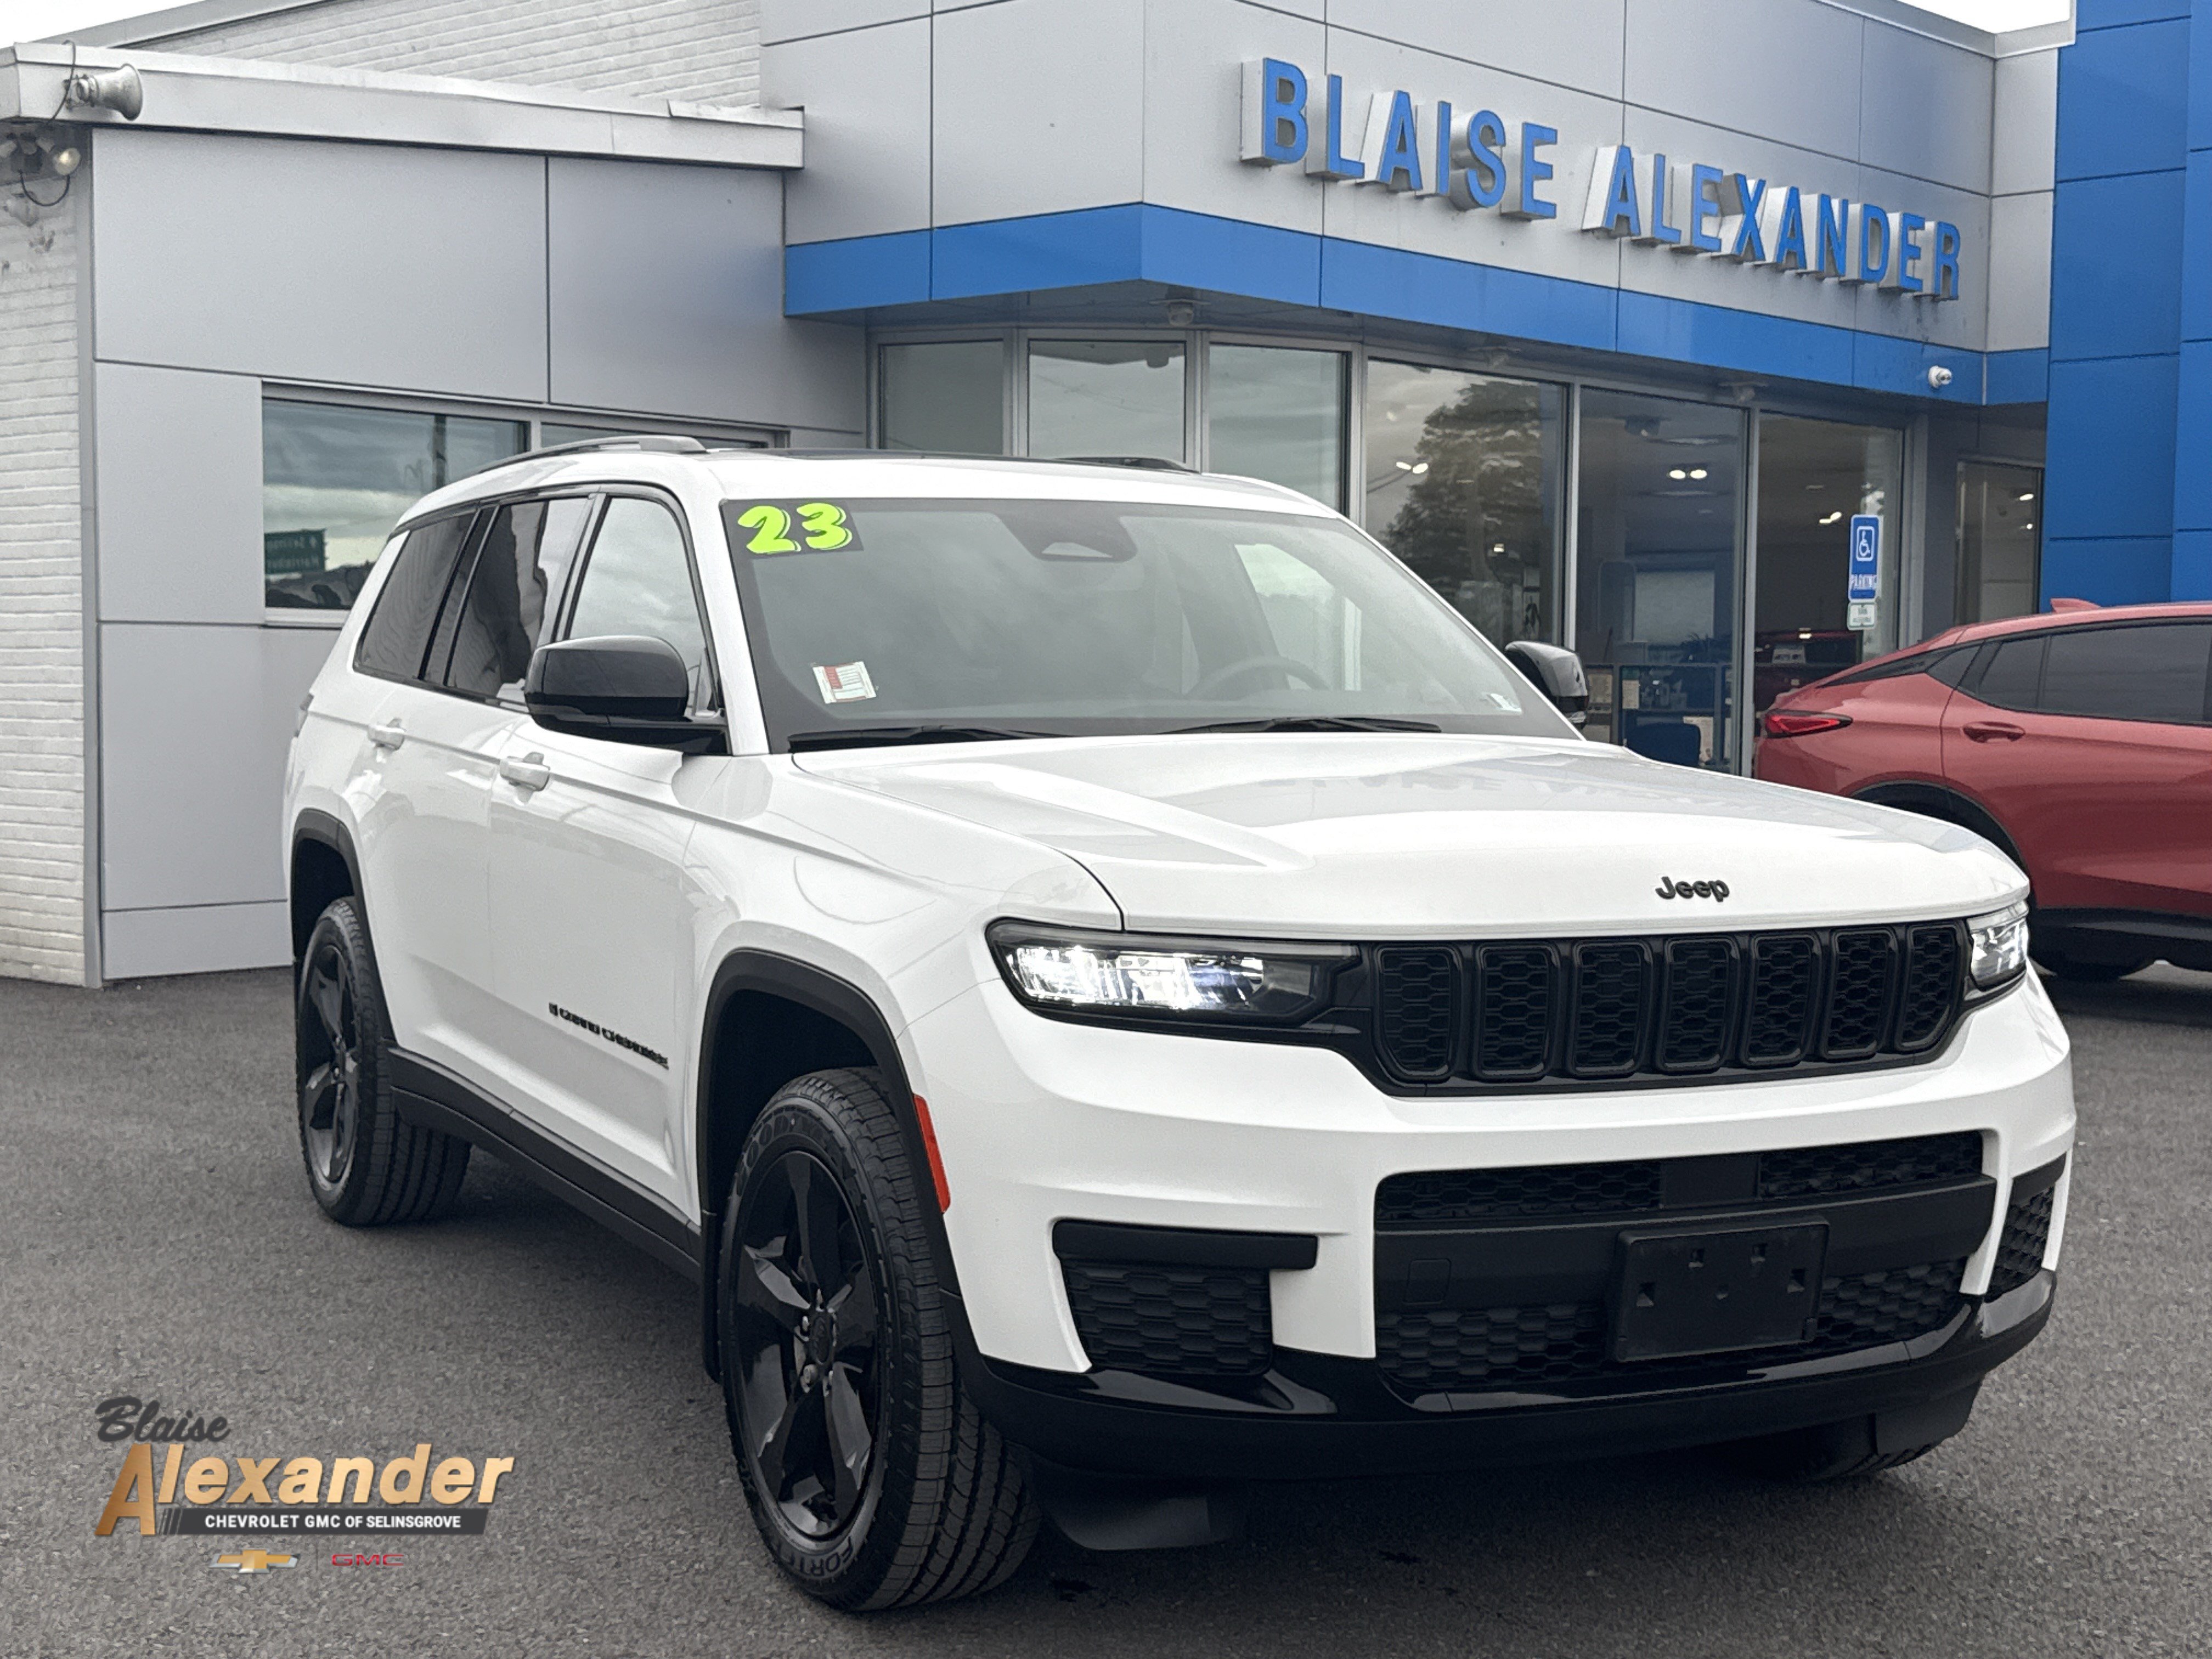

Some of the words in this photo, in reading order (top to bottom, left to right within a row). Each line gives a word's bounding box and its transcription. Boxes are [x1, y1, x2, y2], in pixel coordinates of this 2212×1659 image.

[1262, 57, 1558, 219] BLAISE
[1604, 144, 1960, 301] ALEXANDER
[737, 502, 853, 555] 23
[1655, 876, 1730, 902] Jeep
